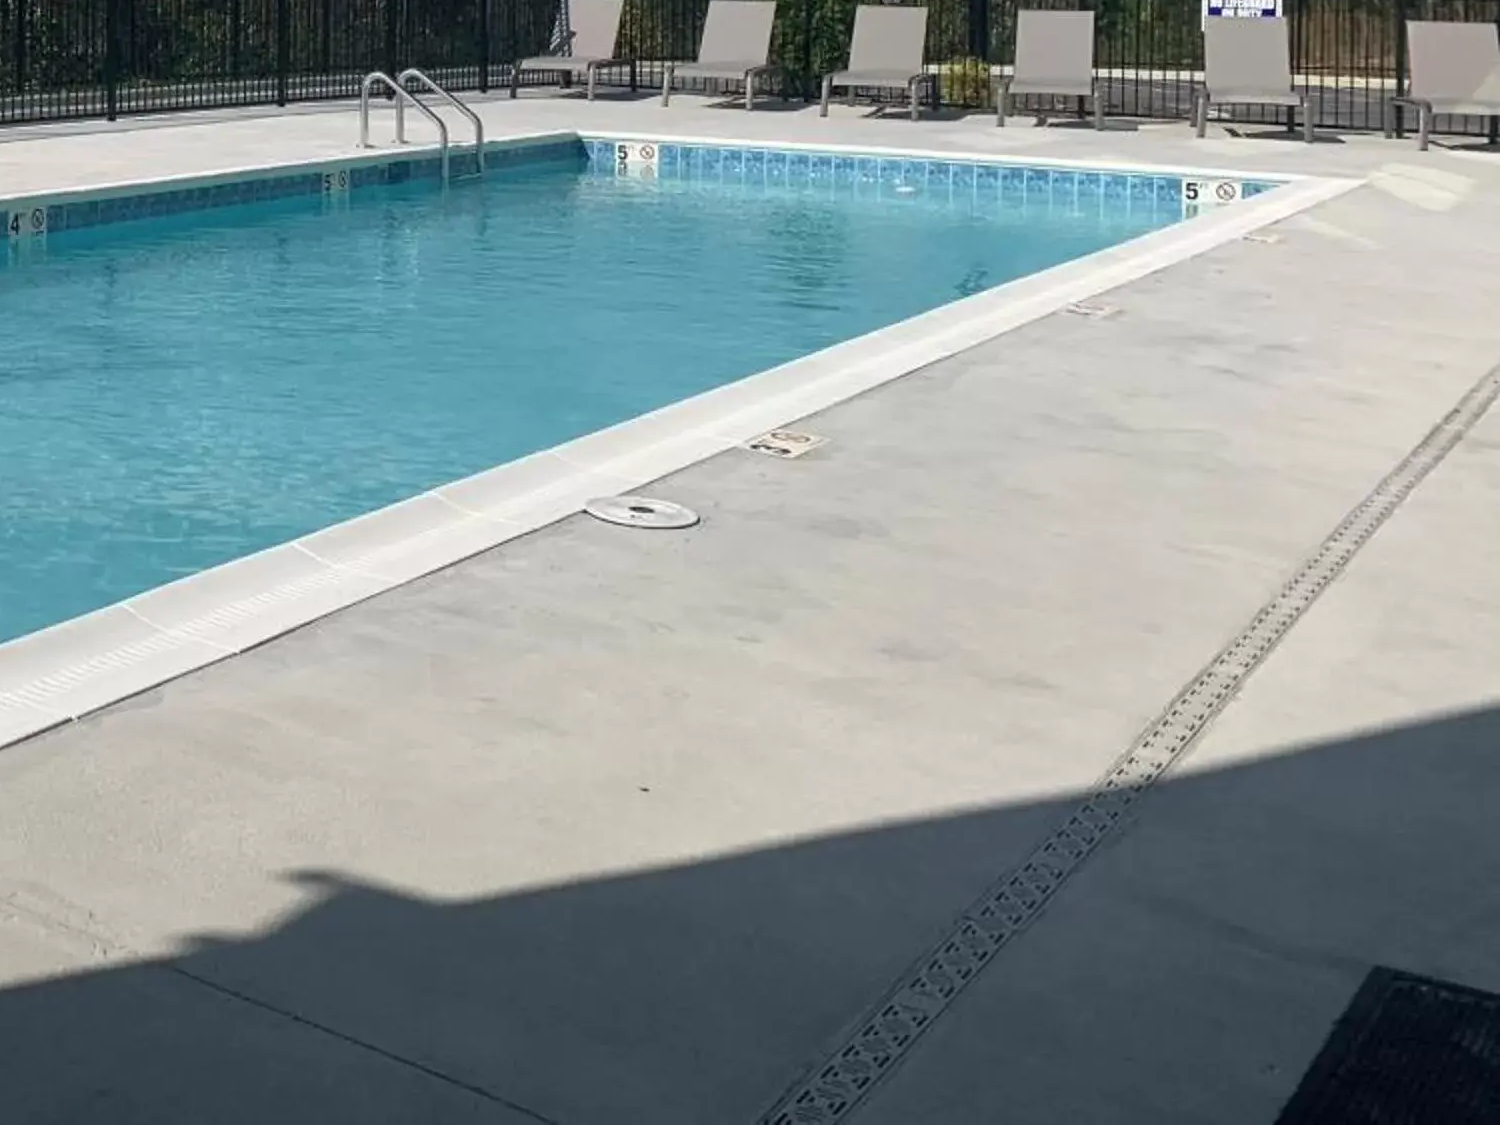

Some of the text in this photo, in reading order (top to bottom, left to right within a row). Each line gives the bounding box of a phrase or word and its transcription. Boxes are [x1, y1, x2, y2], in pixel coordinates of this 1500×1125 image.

[617, 144, 628, 160] 5
[1185, 182, 1199, 200] 5
[10, 212, 20, 236] 4
